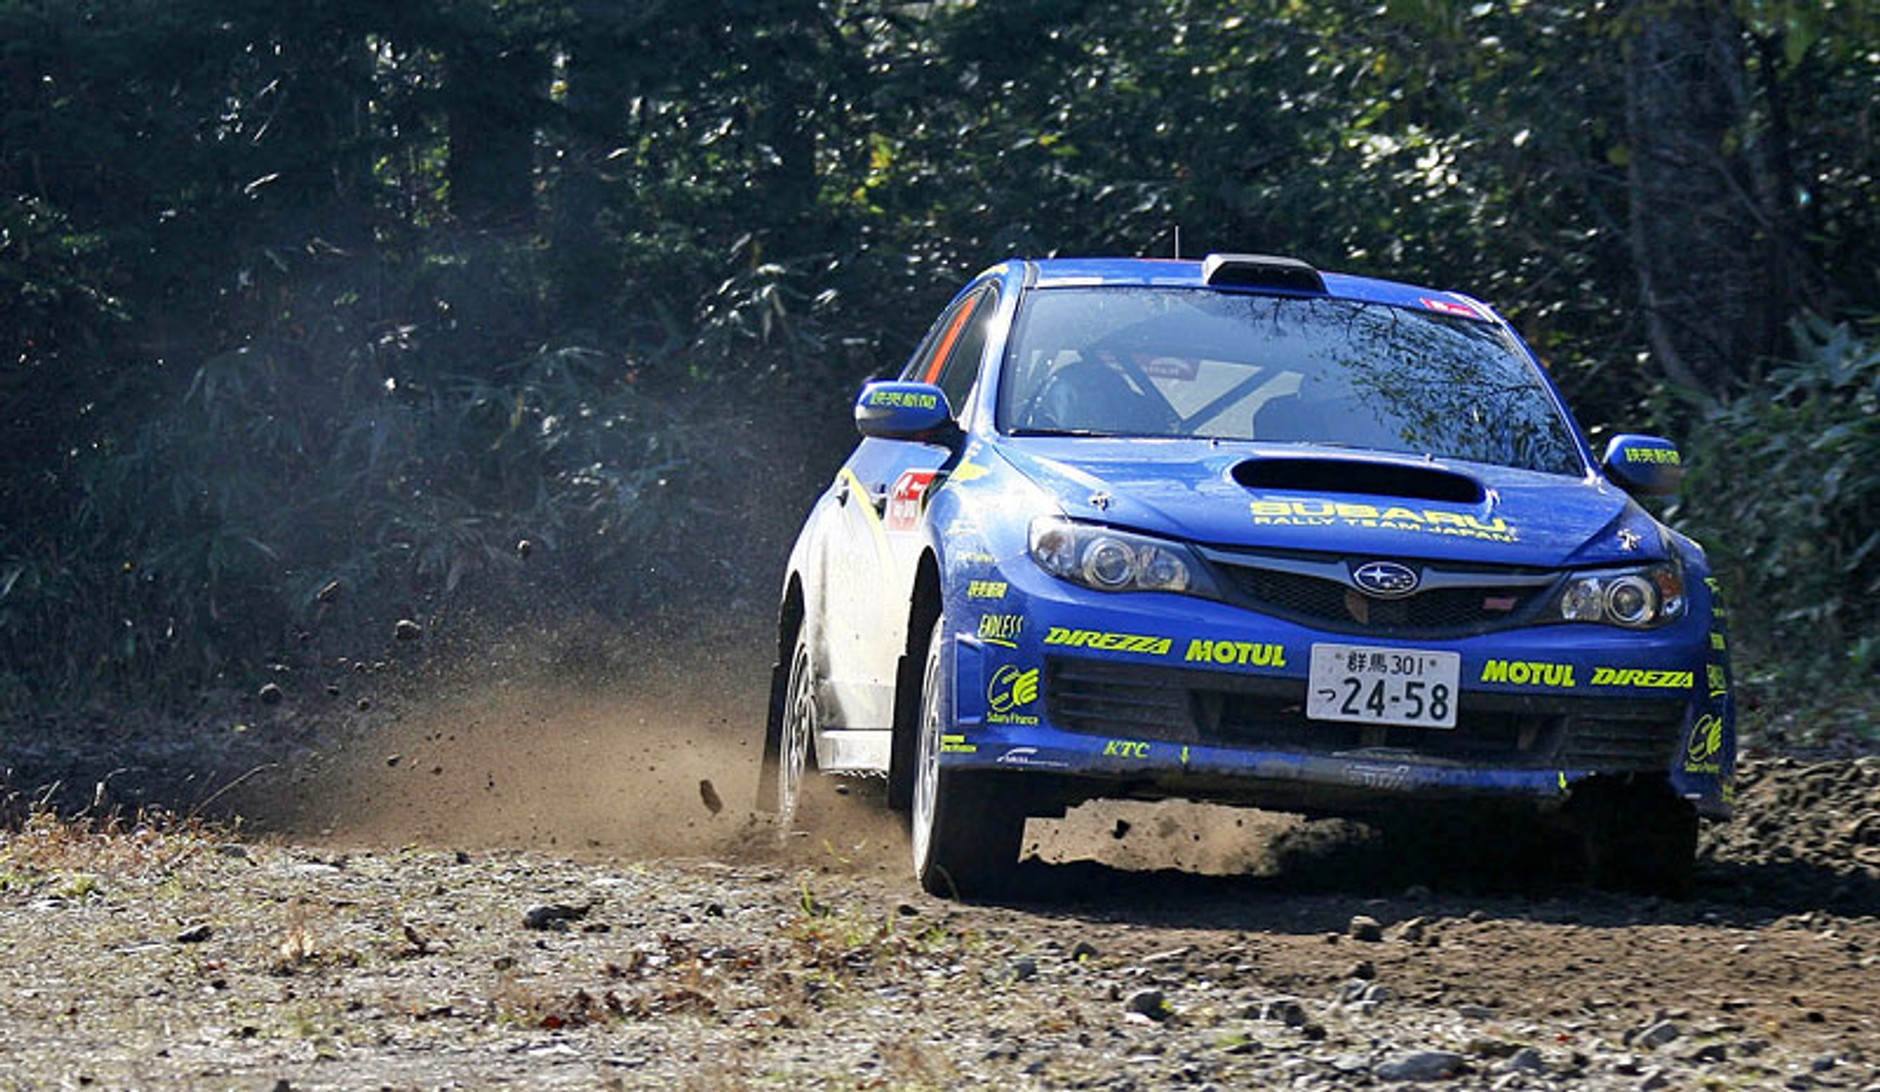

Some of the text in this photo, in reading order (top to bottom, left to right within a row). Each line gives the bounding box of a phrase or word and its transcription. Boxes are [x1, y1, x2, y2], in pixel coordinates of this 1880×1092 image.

[1250, 500, 1508, 533] SUBARU
[1253, 515, 1515, 543] RALLY TEAM JAPAN
[1044, 626, 1173, 655] DIREZZA
[1185, 639, 1287, 668] MOTUL
[1481, 659, 1577, 688] MOTUL
[1590, 666, 1694, 689] DIREZZA
[1317, 676, 1449, 720] つ 24-58
[1103, 739, 1151, 759] KTC
